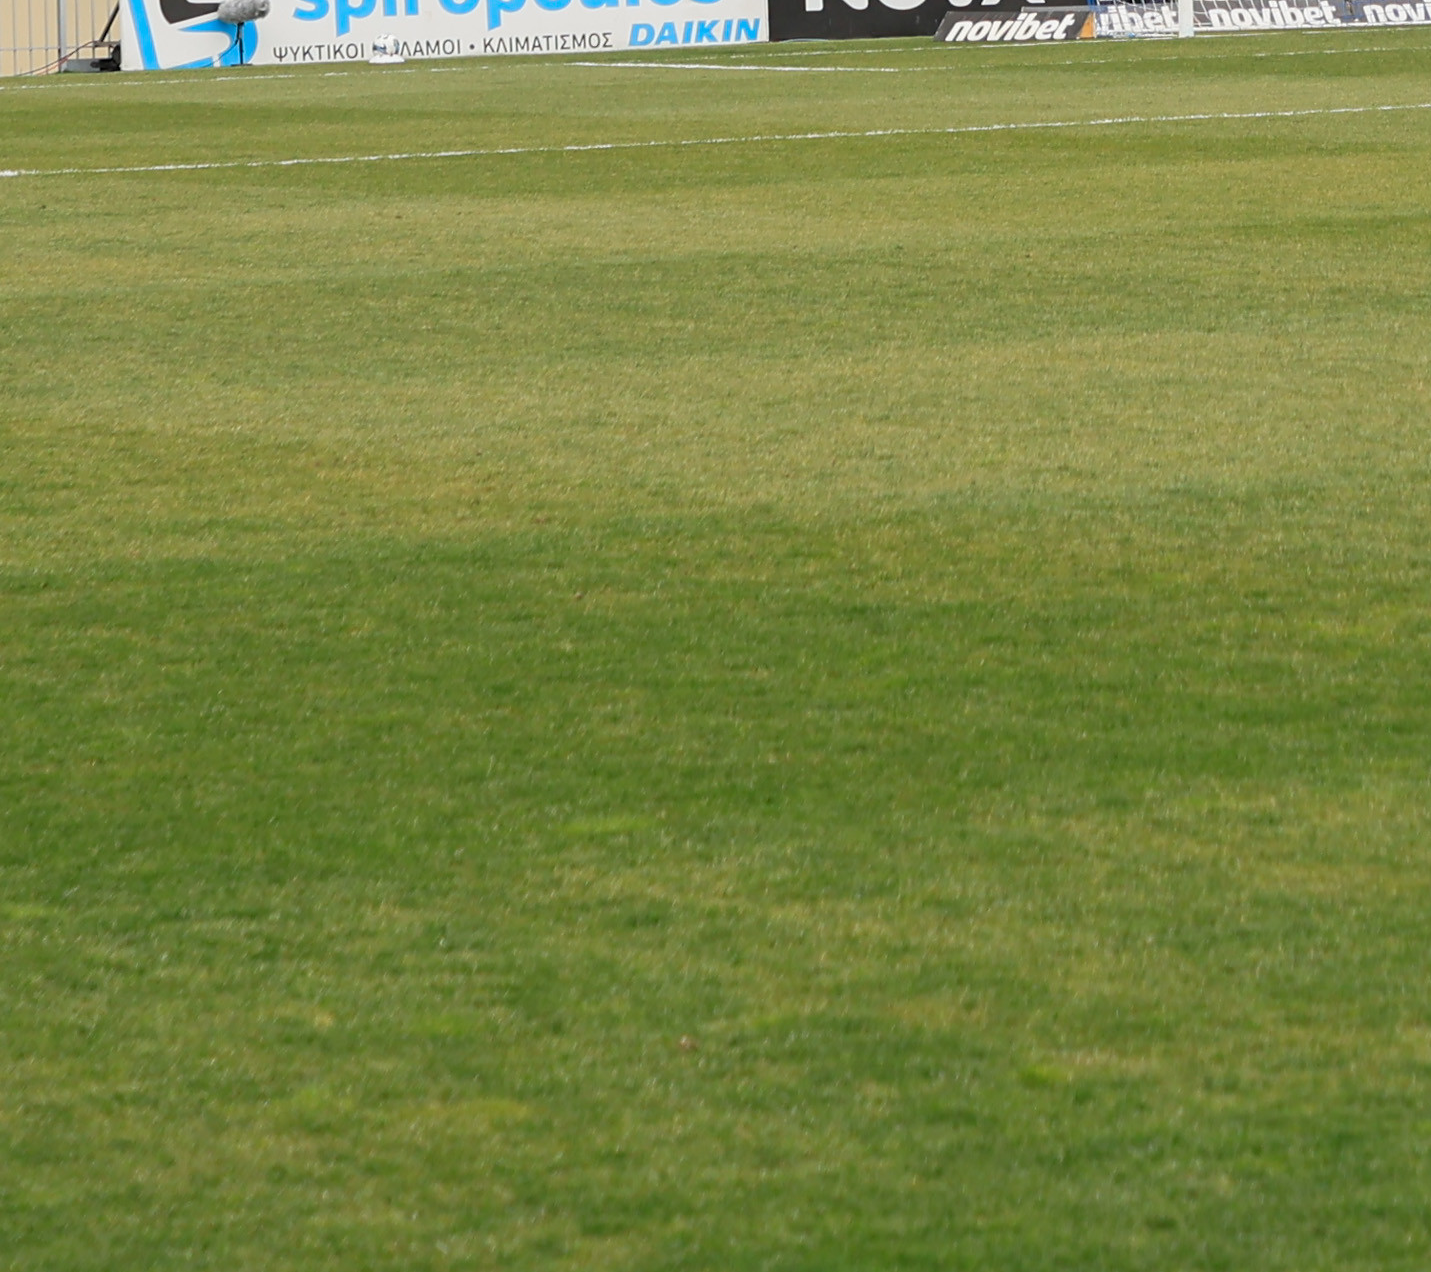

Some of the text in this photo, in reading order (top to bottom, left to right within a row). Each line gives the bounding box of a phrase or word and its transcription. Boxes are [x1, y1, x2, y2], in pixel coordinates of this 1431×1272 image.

[945, 13, 1077, 41] novibet
[1209, 0, 1339, 28] novibet
[628, 17, 761, 46] DAIKIN
[272, 41, 365, 61] ΨΥΚΤΙΚΟΙ
[482, 32, 613, 54] ΚΛΙΜΑΤΙΣΜΟΣ
